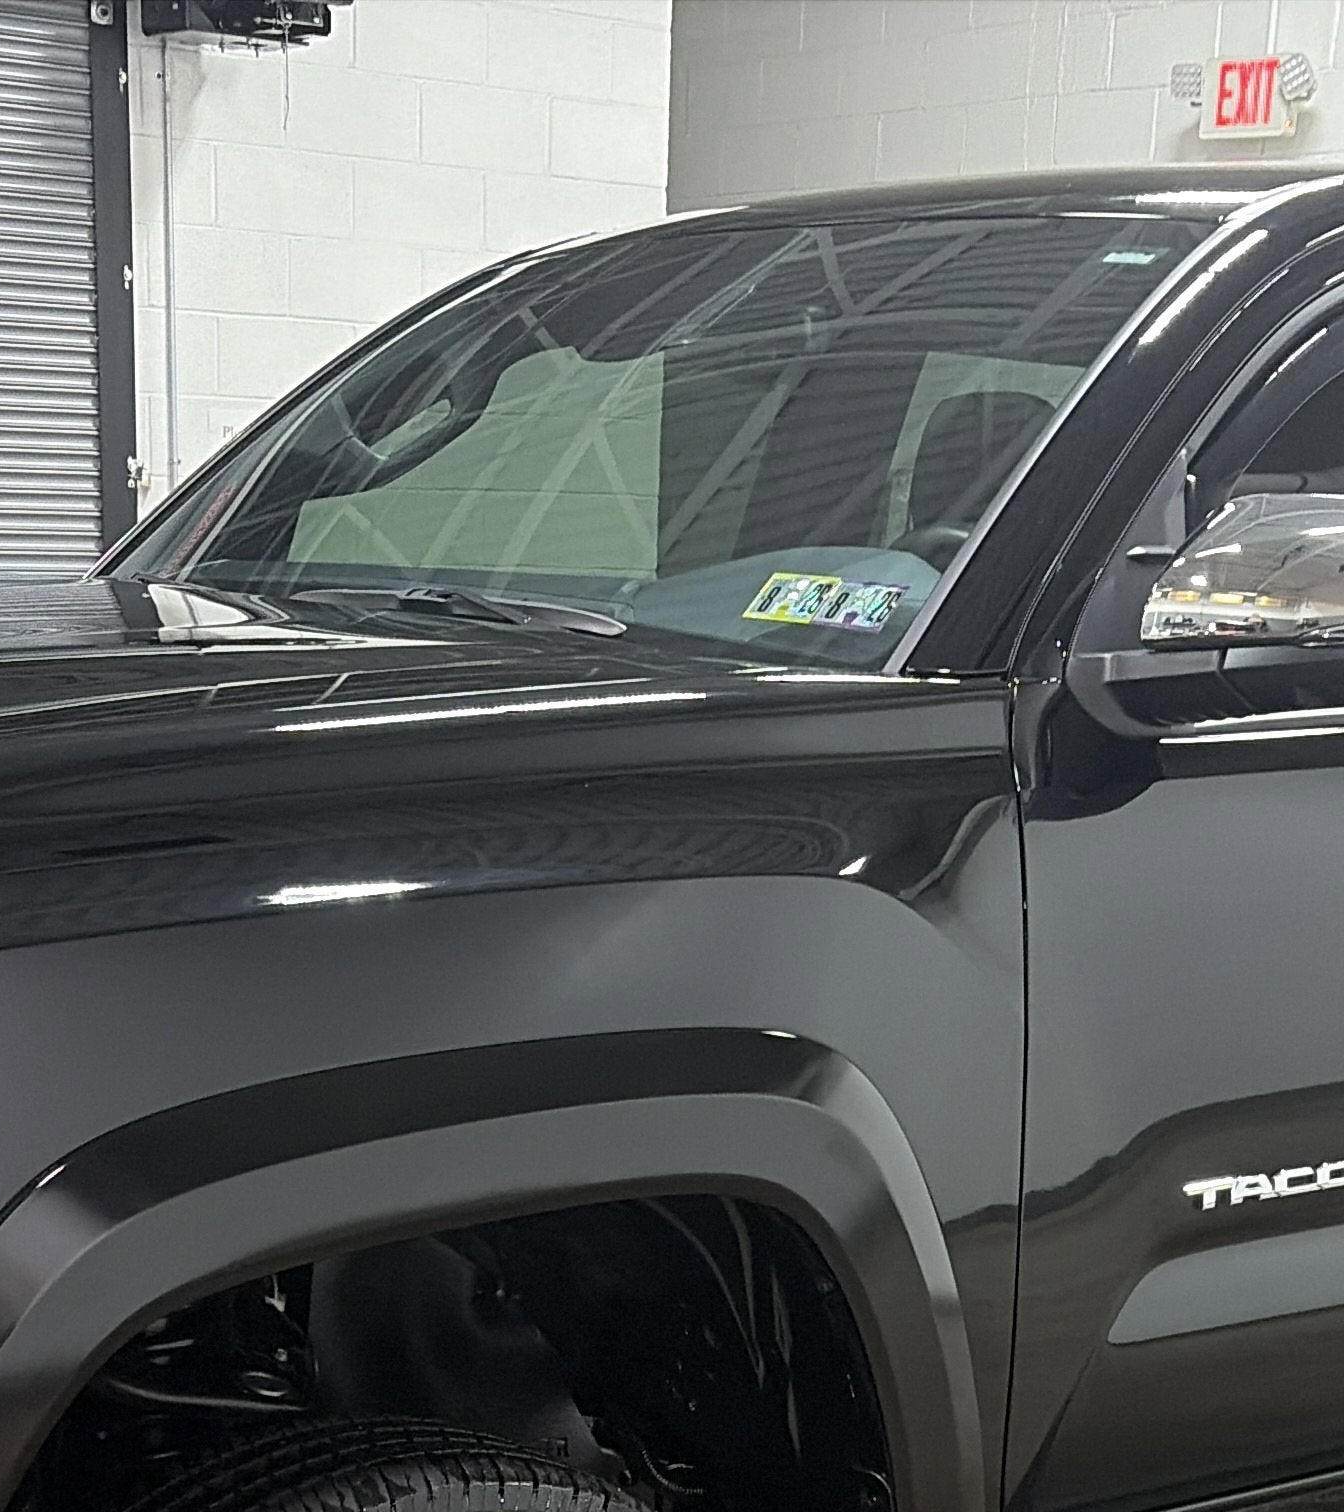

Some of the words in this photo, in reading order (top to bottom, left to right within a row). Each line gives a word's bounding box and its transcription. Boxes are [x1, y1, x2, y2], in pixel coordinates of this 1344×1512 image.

[1215, 58, 1280, 127] EXIT
[757, 586, 782, 612] 8
[825, 592, 850, 619] 8
